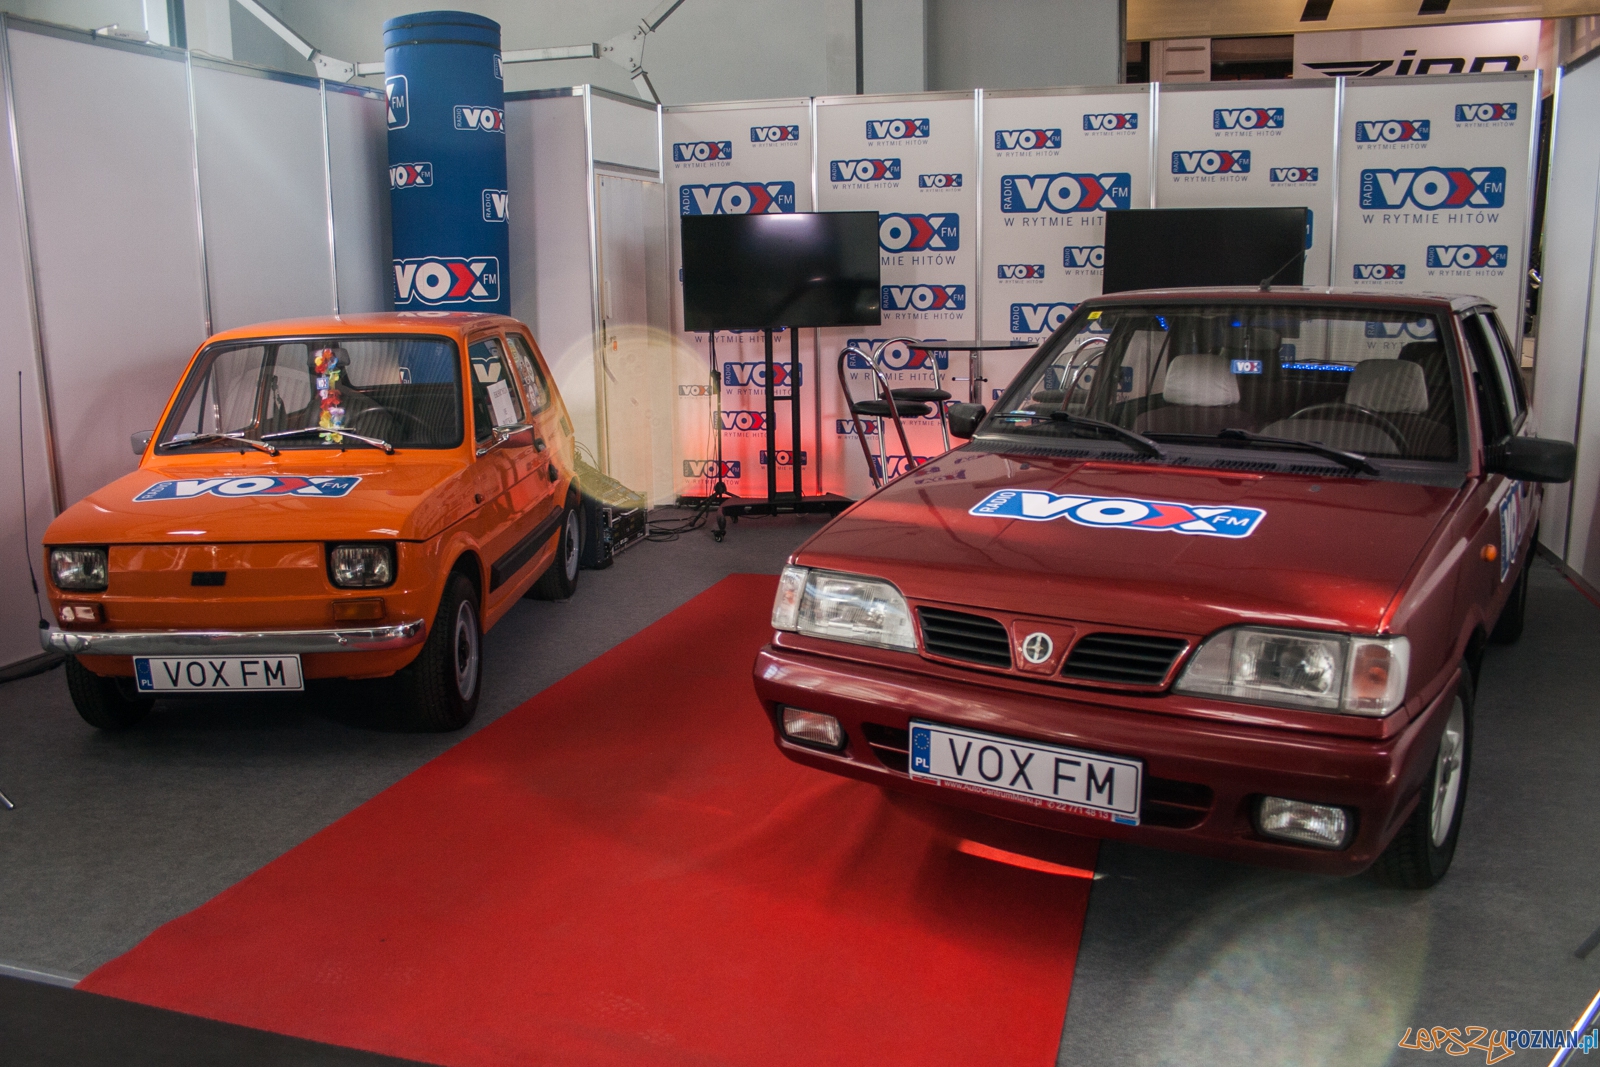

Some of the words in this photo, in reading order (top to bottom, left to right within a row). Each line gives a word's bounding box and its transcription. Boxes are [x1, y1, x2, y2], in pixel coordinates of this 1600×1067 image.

[392, 97, 404, 108] FM
[1089, 115, 1132, 129] VOX
[1221, 109, 1277, 128] VOX
[1462, 105, 1510, 120] VOX
[756, 126, 794, 141] VOX
[873, 120, 923, 138] VOX
[1364, 121, 1422, 141] VOX
[1002, 130, 1055, 149] VOX
[679, 143, 726, 160] VOX
[837, 160, 893, 180] VOX
[1180, 152, 1242, 173] VOX
[923, 175, 957, 187] VOX
[1275, 168, 1314, 181] VOX
[1004, 179, 1012, 210] RADIO
[1014, 176, 1117, 210] VOX
[1112, 187, 1128, 197] FM
[1363, 173, 1374, 206] RADIO
[1375, 170, 1491, 207] VOX
[1484, 183, 1502, 193] FM
[691, 185, 783, 215] VOX
[778, 195, 793, 204] FM
[1004, 218, 1015, 227] W
[1023, 217, 1073, 227] RYTMIE
[1081, 216, 1104, 226] HIT
[1362, 214, 1374, 224] W
[1383, 214, 1439, 224] RYTMIE
[1448, 211, 1499, 224] HITÓW
[879, 216, 947, 249] OX
[941, 227, 956, 237] FM
[881, 256, 904, 265] MIE
[912, 253, 956, 265] HITÓW
[1071, 247, 1105, 267] VO
[1435, 246, 1500, 267] VOX
[395, 262, 489, 299] VOX
[483, 274, 497, 285] FM
[1003, 265, 1040, 278] VOX
[1359, 265, 1399, 279] VOX
[890, 286, 957, 309] VOX
[175, 477, 336, 496] VOX
[979, 492, 1016, 512] RADIO
[1021, 492, 1232, 532] VOX
[1213, 515, 1250, 527] FM
[163, 660, 230, 687] VOX
[240, 660, 286, 687] FM
[915, 757, 929, 769] PL
[948, 738, 1035, 790] VOX
[1053, 757, 1115, 806] FM
[1056, 802, 1067, 811] 22
[1068, 804, 1083, 814] 771
[1085, 807, 1096, 816] 48
[1099, 810, 1108, 819] 13
